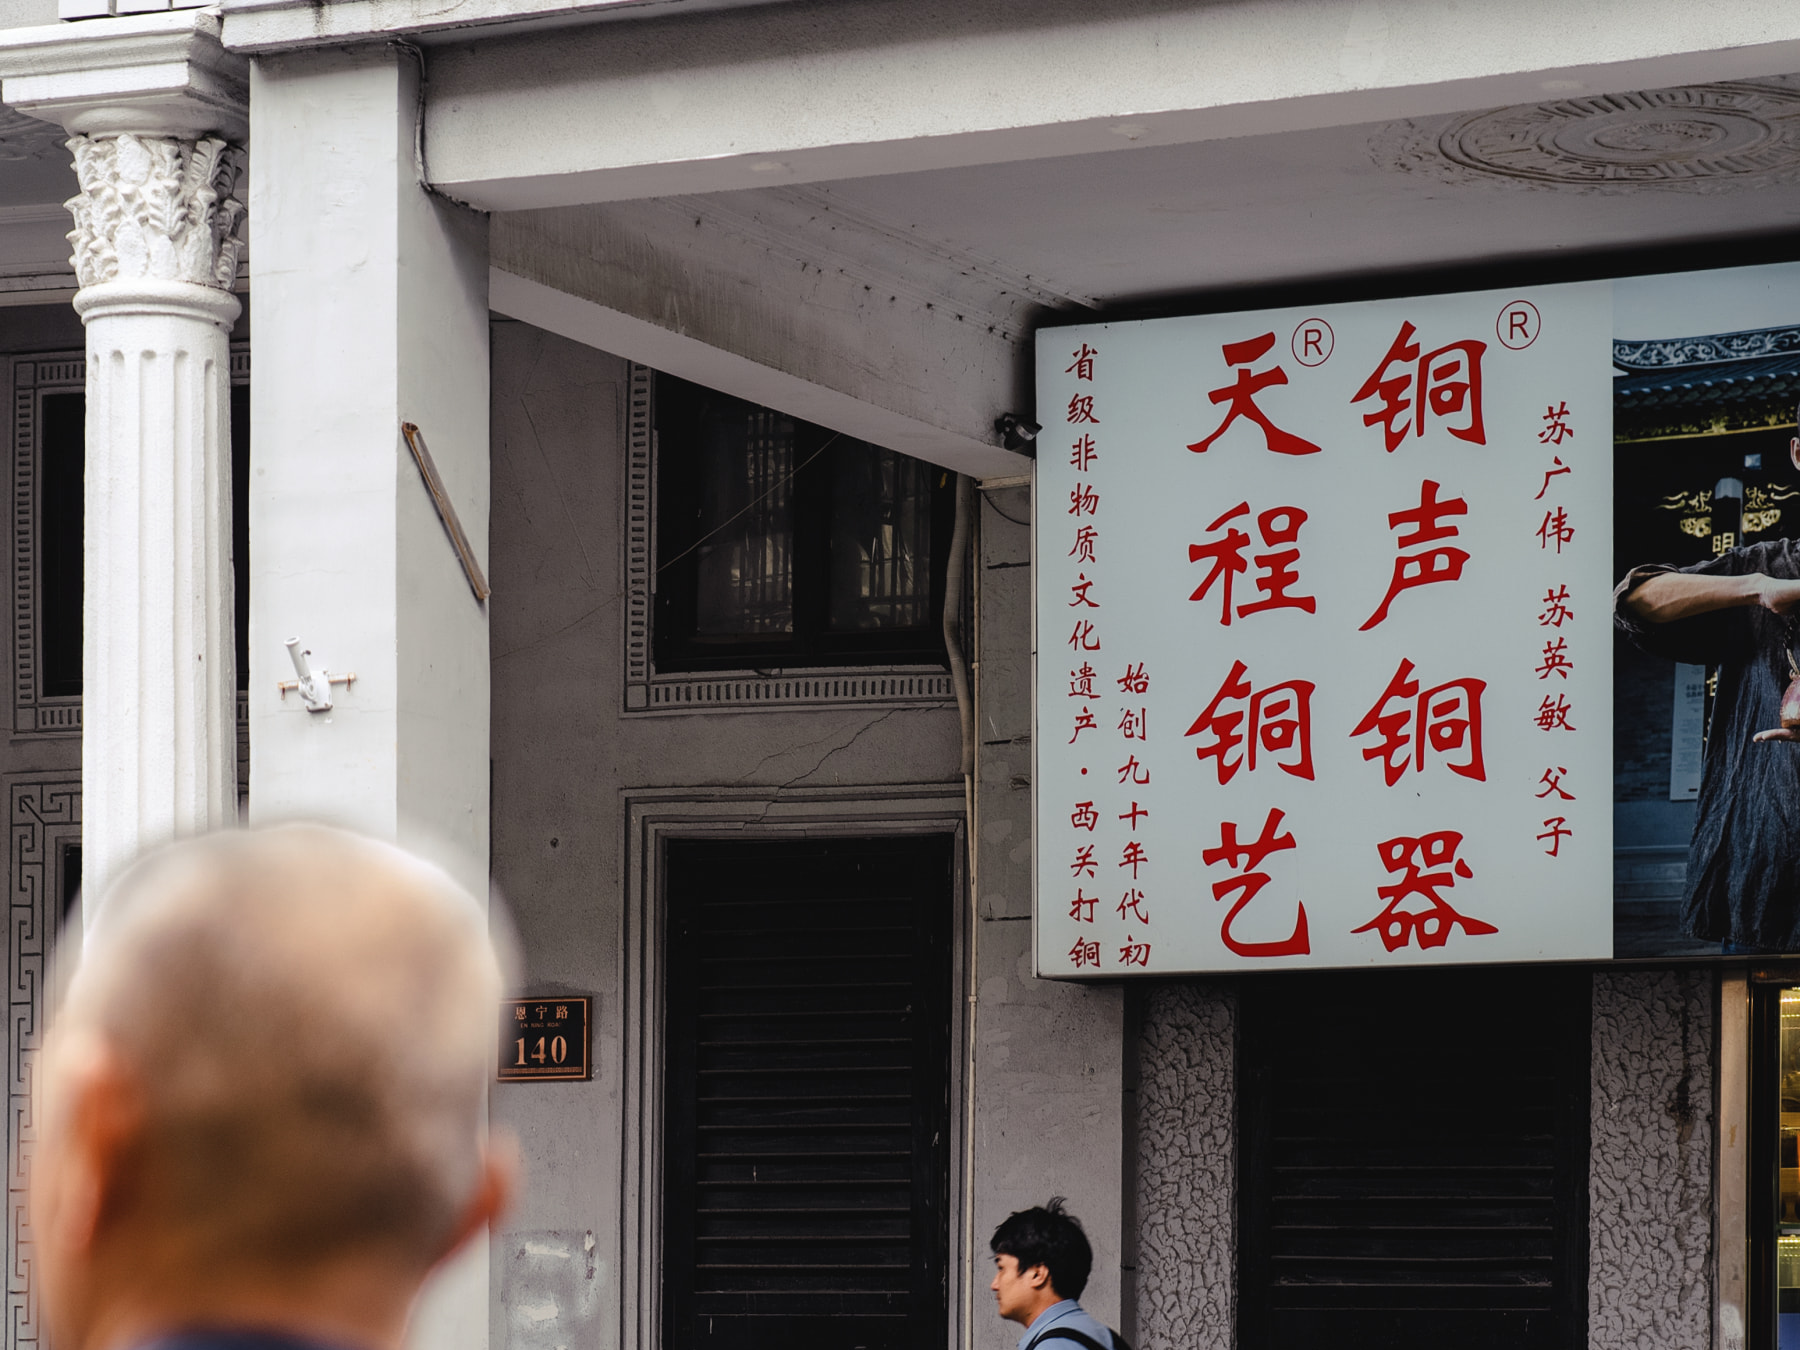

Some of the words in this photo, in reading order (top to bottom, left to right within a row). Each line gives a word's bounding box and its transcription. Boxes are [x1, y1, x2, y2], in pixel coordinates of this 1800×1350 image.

[1534, 402, 1575, 554] 苏广伟
[1184, 331, 1323, 957] 天程铜艺
[1349, 320, 1499, 953] 铜声铜器
[1534, 584, 1576, 732] 苏英敏
[1117, 662, 1151, 968] 始创九十年代初
[1535, 766, 1576, 857] 父子
[514, 1035, 568, 1066] 140
[515, 1005, 569, 1020] 恩宁路
